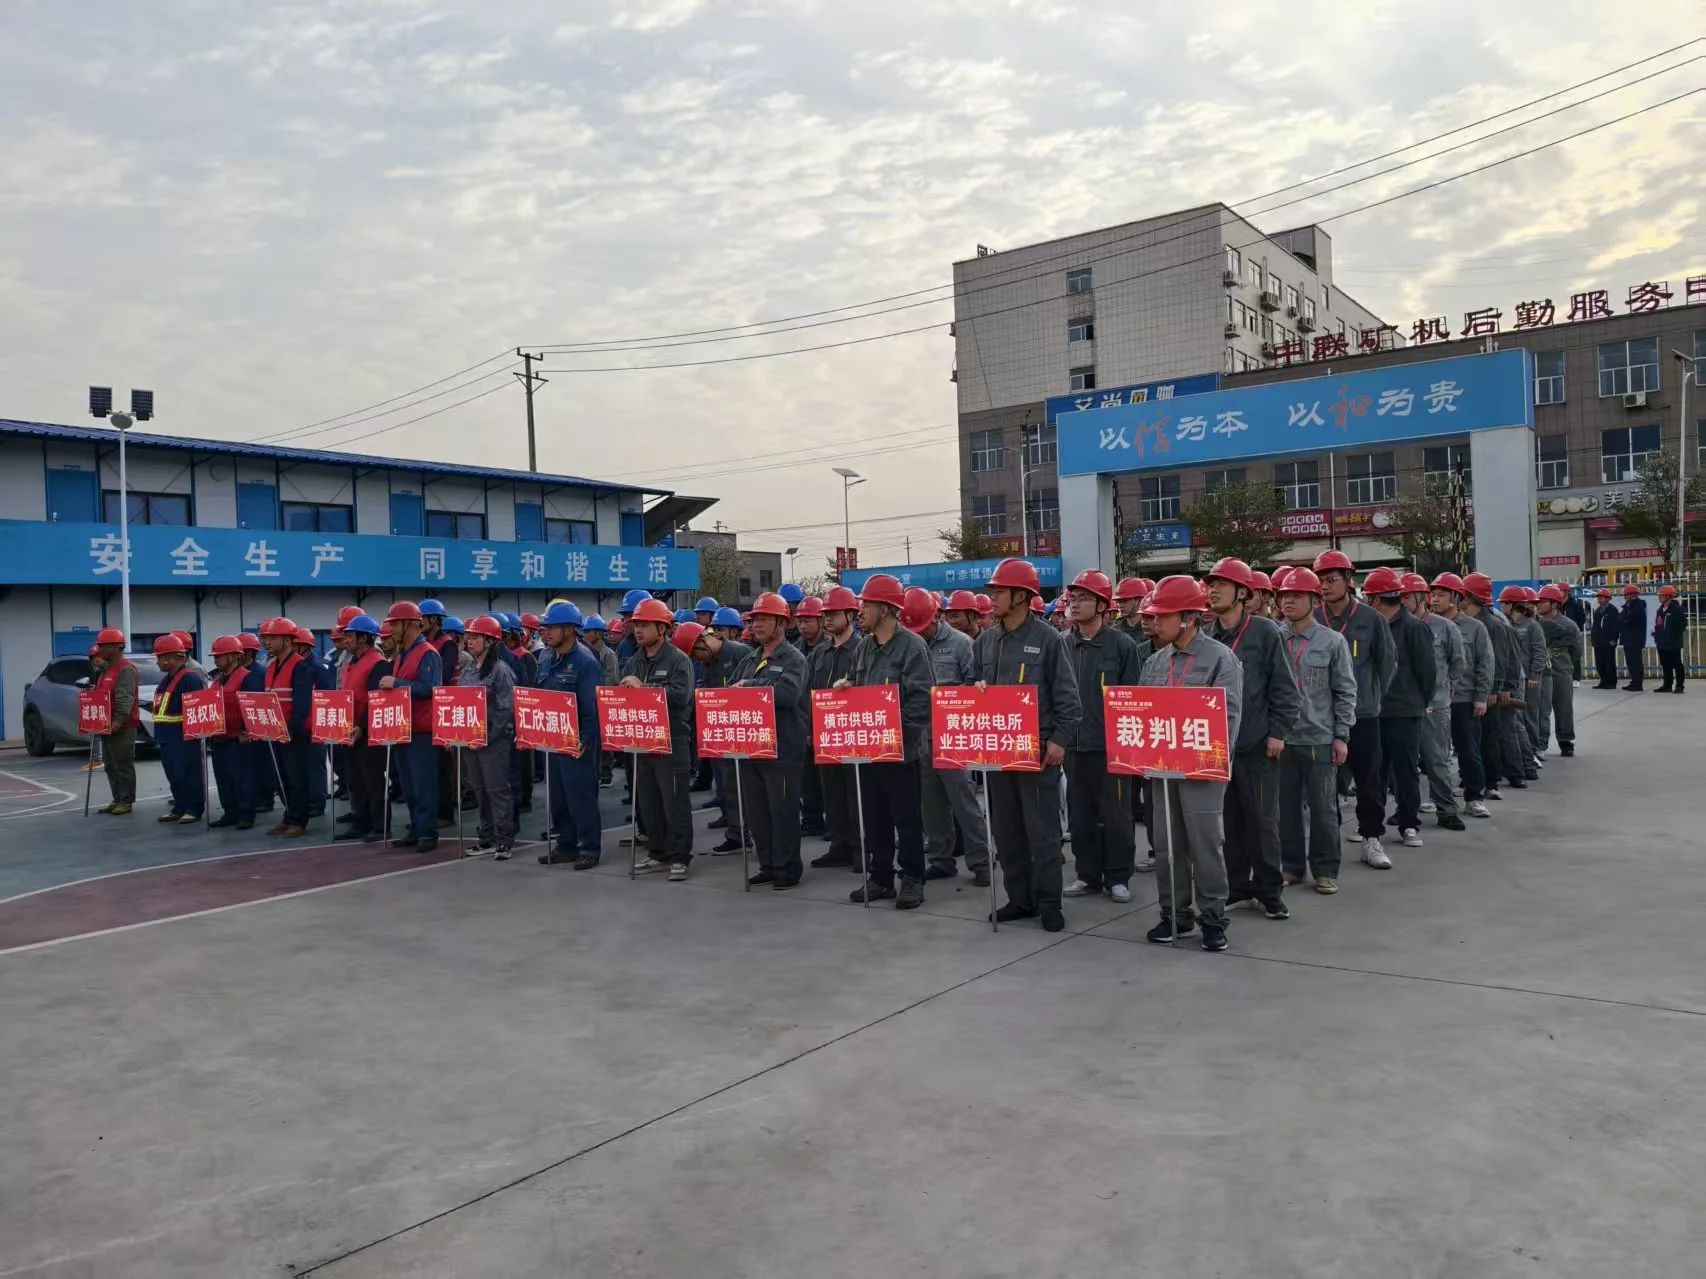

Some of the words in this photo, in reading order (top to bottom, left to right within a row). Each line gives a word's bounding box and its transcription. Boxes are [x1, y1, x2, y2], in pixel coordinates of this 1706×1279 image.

[1288, 382, 1464, 431] 以和为贵
[90, 533, 345, 578] 安全生产
[419, 546, 669, 584] 同享和谐生活
[372, 705, 406, 728] 启明队
[438, 705, 480, 727] 汇捷队
[519, 706, 575, 735] 汇欣源队
[608, 708, 658, 723] 坝塘供电所
[706, 710, 763, 725] 明珠网格站
[823, 710, 888, 729] 横市供电所
[946, 712, 1023, 731] 黄材供电所
[605, 723, 665, 739] 业主项目分部
[702, 727, 771, 742] 业主项目分部
[819, 727, 896, 748] 业主项目分部
[1116, 714, 1212, 751] 裁判组
[939, 733, 1032, 751] 业主项目分部
